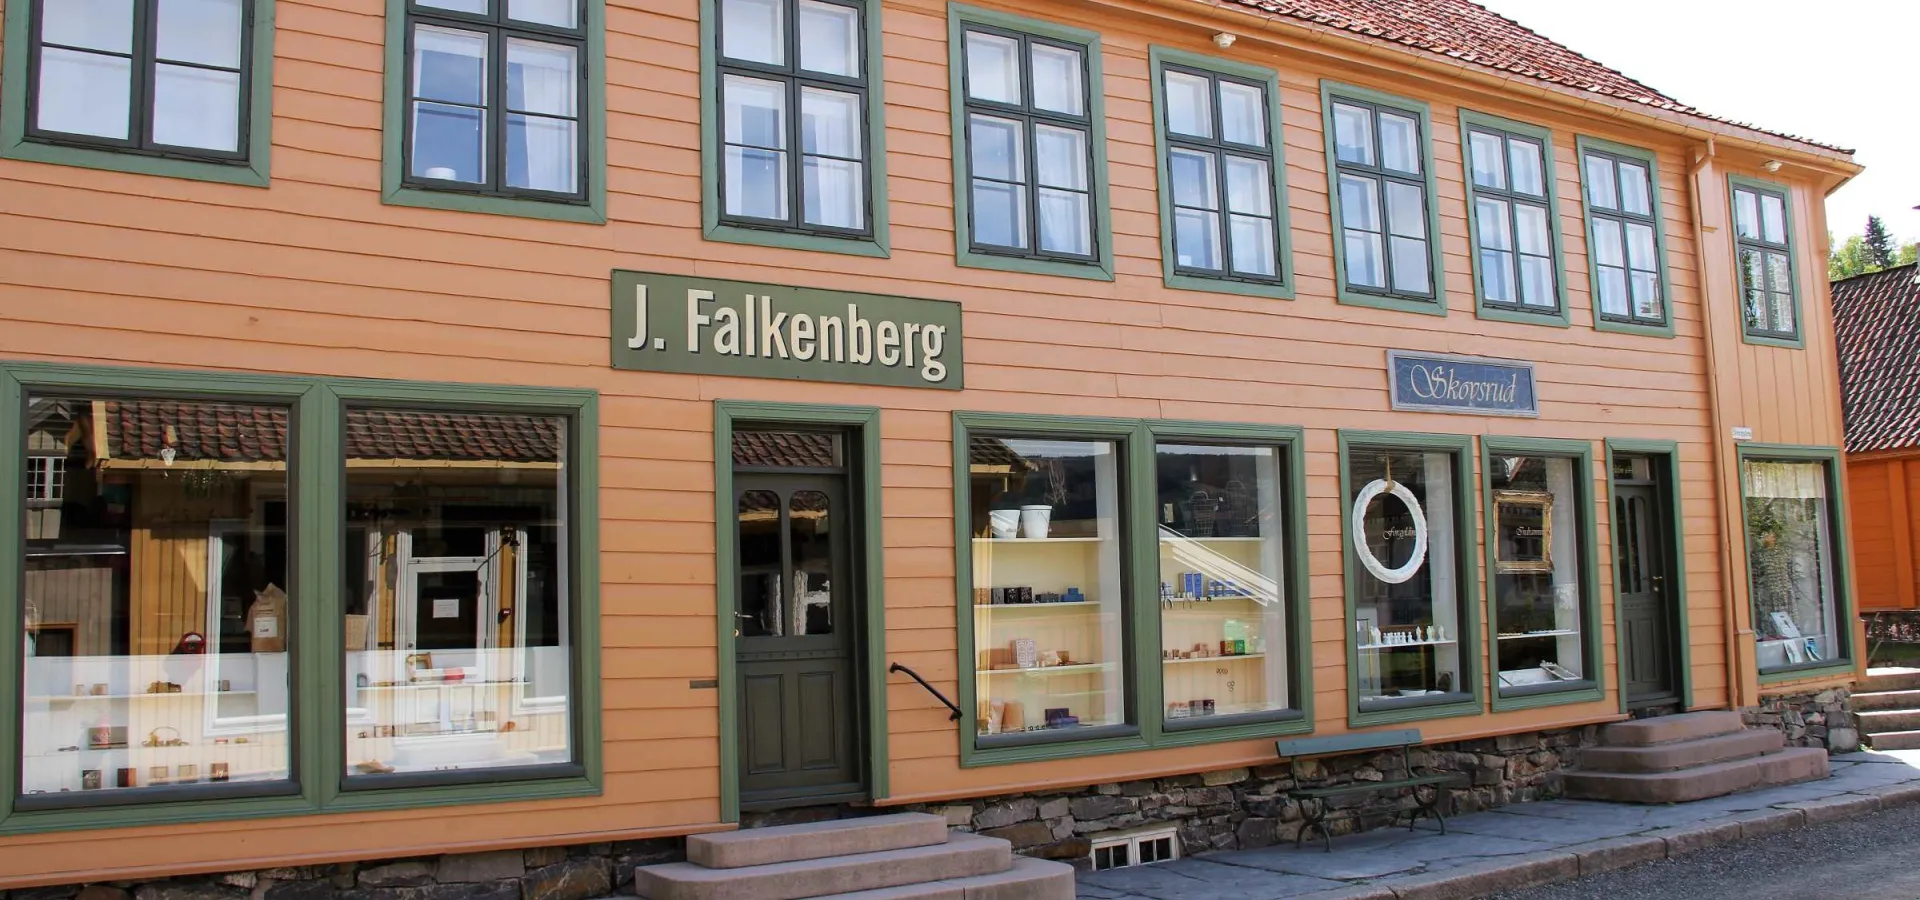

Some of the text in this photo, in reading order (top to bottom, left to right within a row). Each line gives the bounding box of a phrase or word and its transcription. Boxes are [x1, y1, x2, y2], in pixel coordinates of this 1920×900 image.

[628, 284, 948, 382] J. Falkenberg
[1410, 364, 1517, 403] Skovsrud
